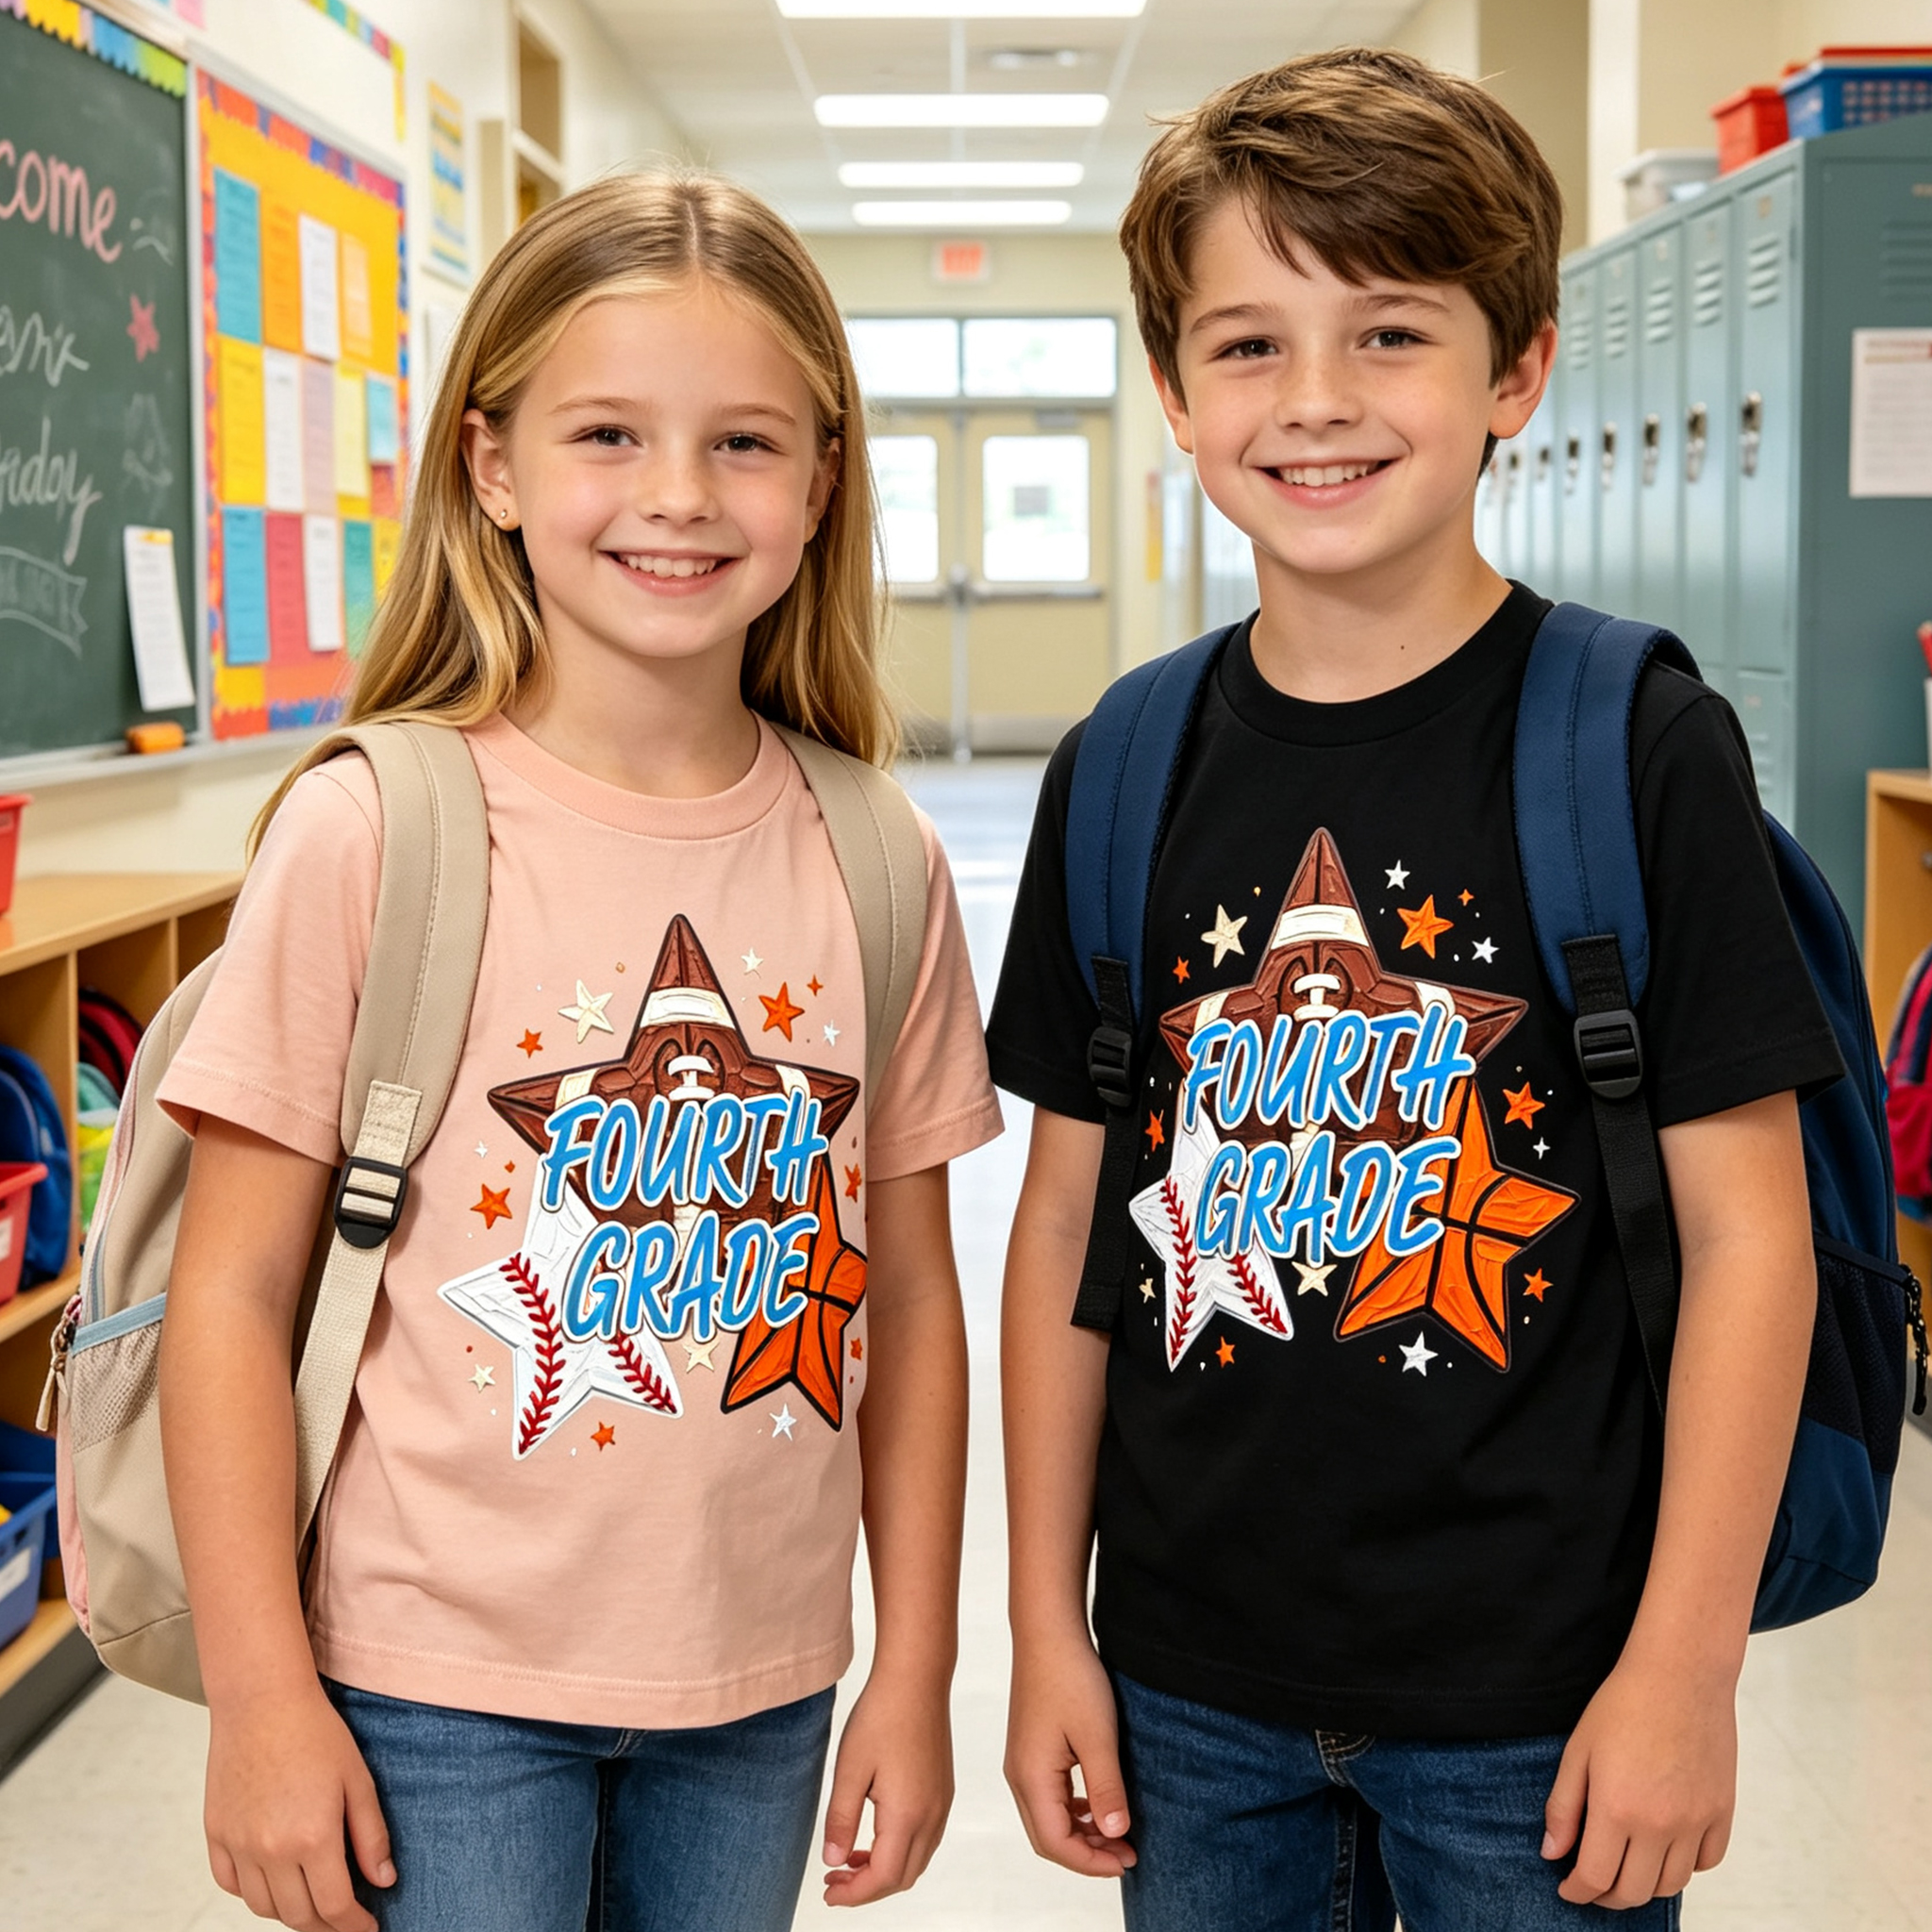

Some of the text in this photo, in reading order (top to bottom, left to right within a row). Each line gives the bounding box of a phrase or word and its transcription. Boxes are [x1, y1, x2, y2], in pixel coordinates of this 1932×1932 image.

[1183, 1002, 1475, 1131] FOURTH
[541, 1087, 828, 1211] FOURTH
[1195, 1131, 1461, 1267] GRADE
[565, 1209, 820, 1342] GRADE
